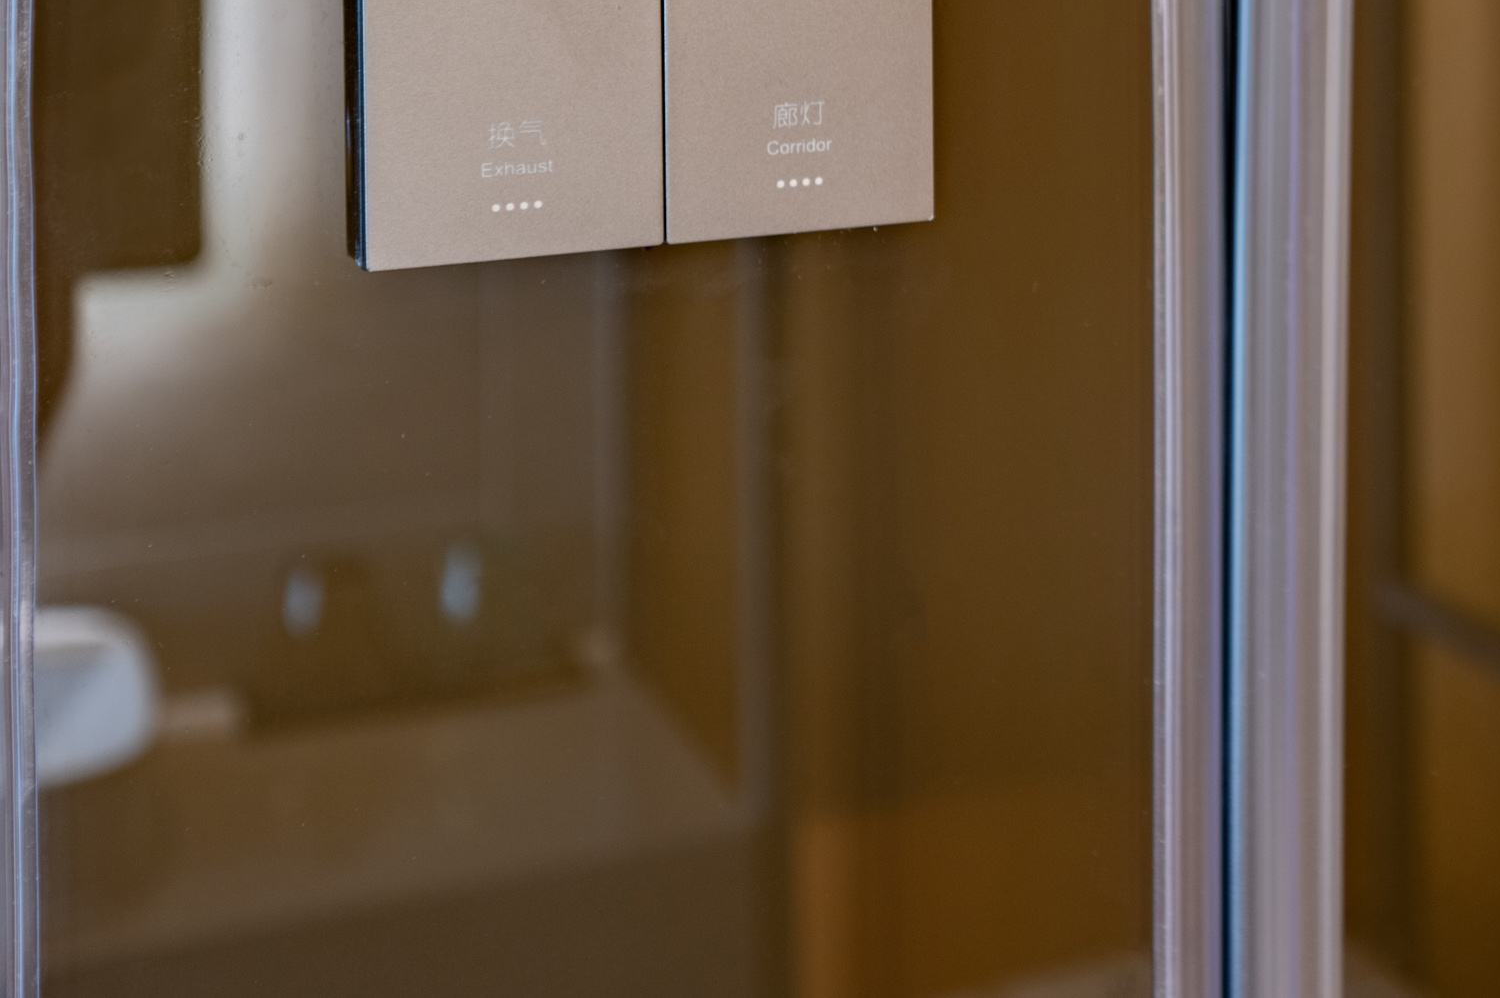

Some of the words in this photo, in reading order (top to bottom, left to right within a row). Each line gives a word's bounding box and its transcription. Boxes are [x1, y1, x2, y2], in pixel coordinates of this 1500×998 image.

[773, 101, 826, 129] 廊灯
[488, 120, 546, 149] 换气
[766, 138, 832, 155] Corridor
[481, 159, 553, 178] Exhaust
